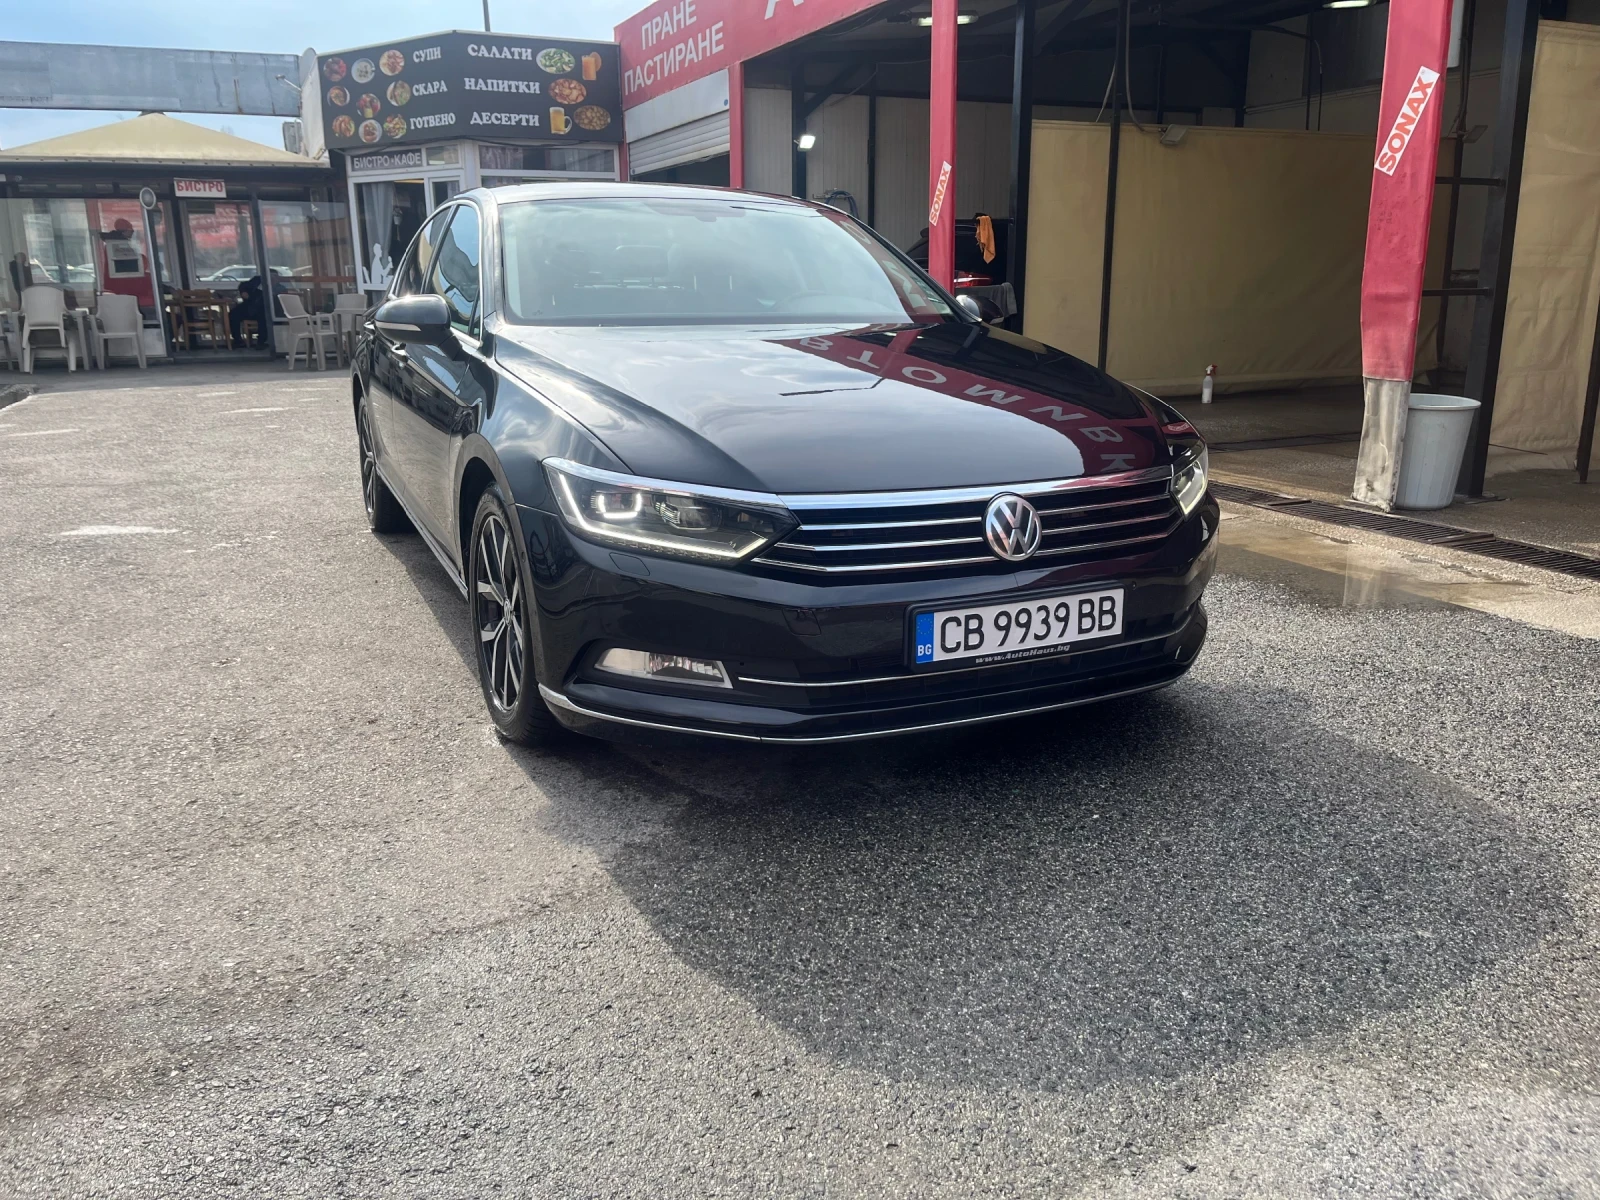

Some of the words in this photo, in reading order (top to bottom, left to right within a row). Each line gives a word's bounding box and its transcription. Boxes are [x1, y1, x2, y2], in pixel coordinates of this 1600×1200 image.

[641, 0, 697, 51] ПРАНЕ
[412, 46, 442, 63] СУПИ
[467, 43, 533, 61] САЛАТИ
[624, 20, 724, 96] ПАСТИРАНЕ
[412, 80, 448, 97] СКАРА
[463, 77, 541, 94] НАПИТКИ
[409, 112, 456, 130] ГОТВЕНО
[469, 111, 540, 127] ДЕСЕРТИ
[1378, 75, 1435, 173] SONAX
[176, 180, 224, 193] БИСТРО
[930, 168, 949, 224] SONAX
[993, 601, 1071, 648] 9939
[917, 643, 932, 657] BG
[975, 644, 1071, 664] www.AutoHaus.bg
